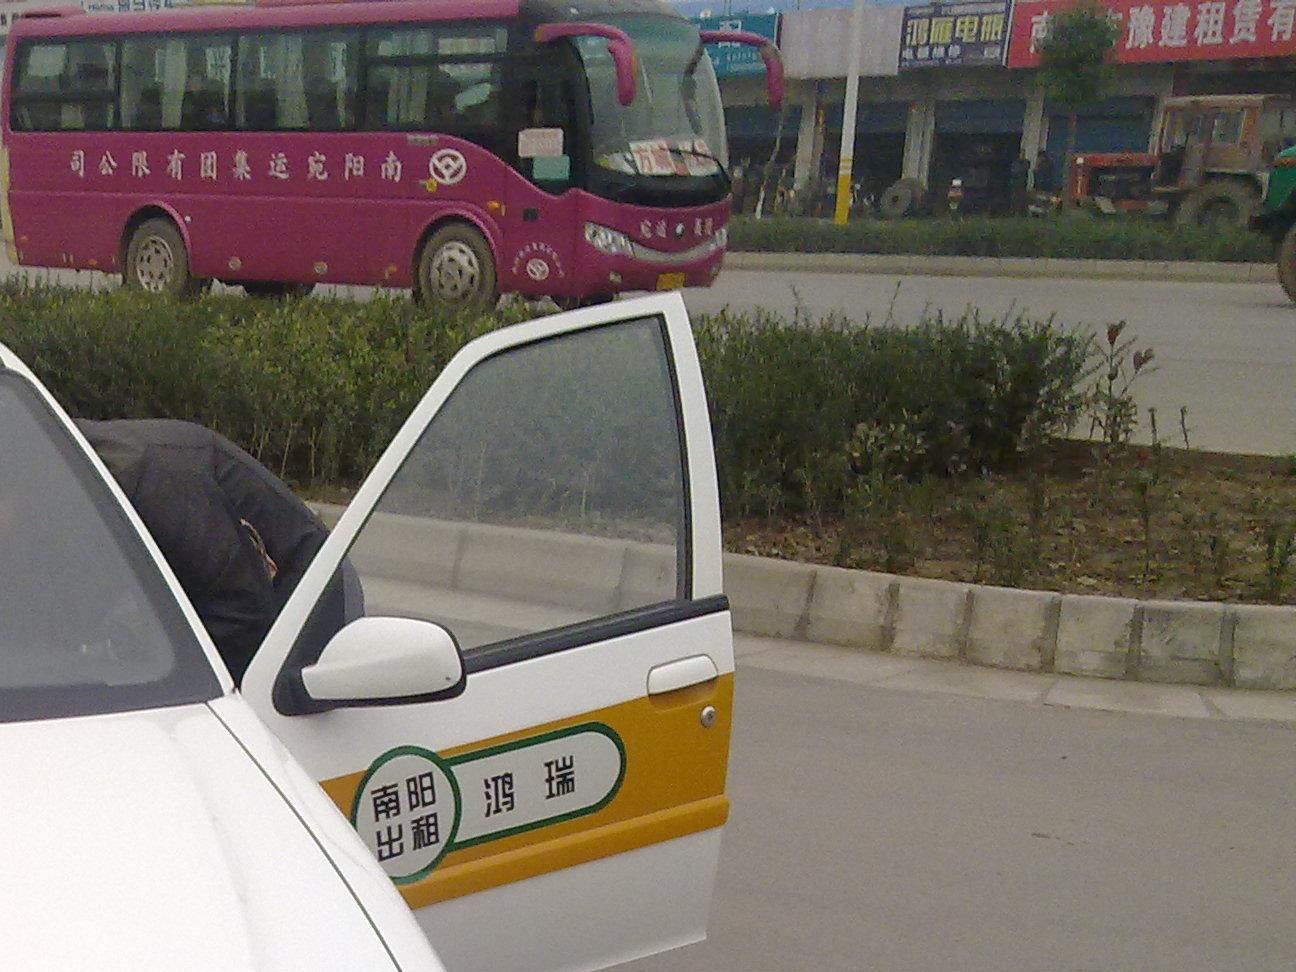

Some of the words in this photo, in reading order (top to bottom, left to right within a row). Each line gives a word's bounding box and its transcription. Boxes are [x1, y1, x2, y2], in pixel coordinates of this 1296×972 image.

[370, 771, 437, 823] 南阳
[483, 754, 576, 819] 鸿瑞
[376, 812, 441, 863] 出租
